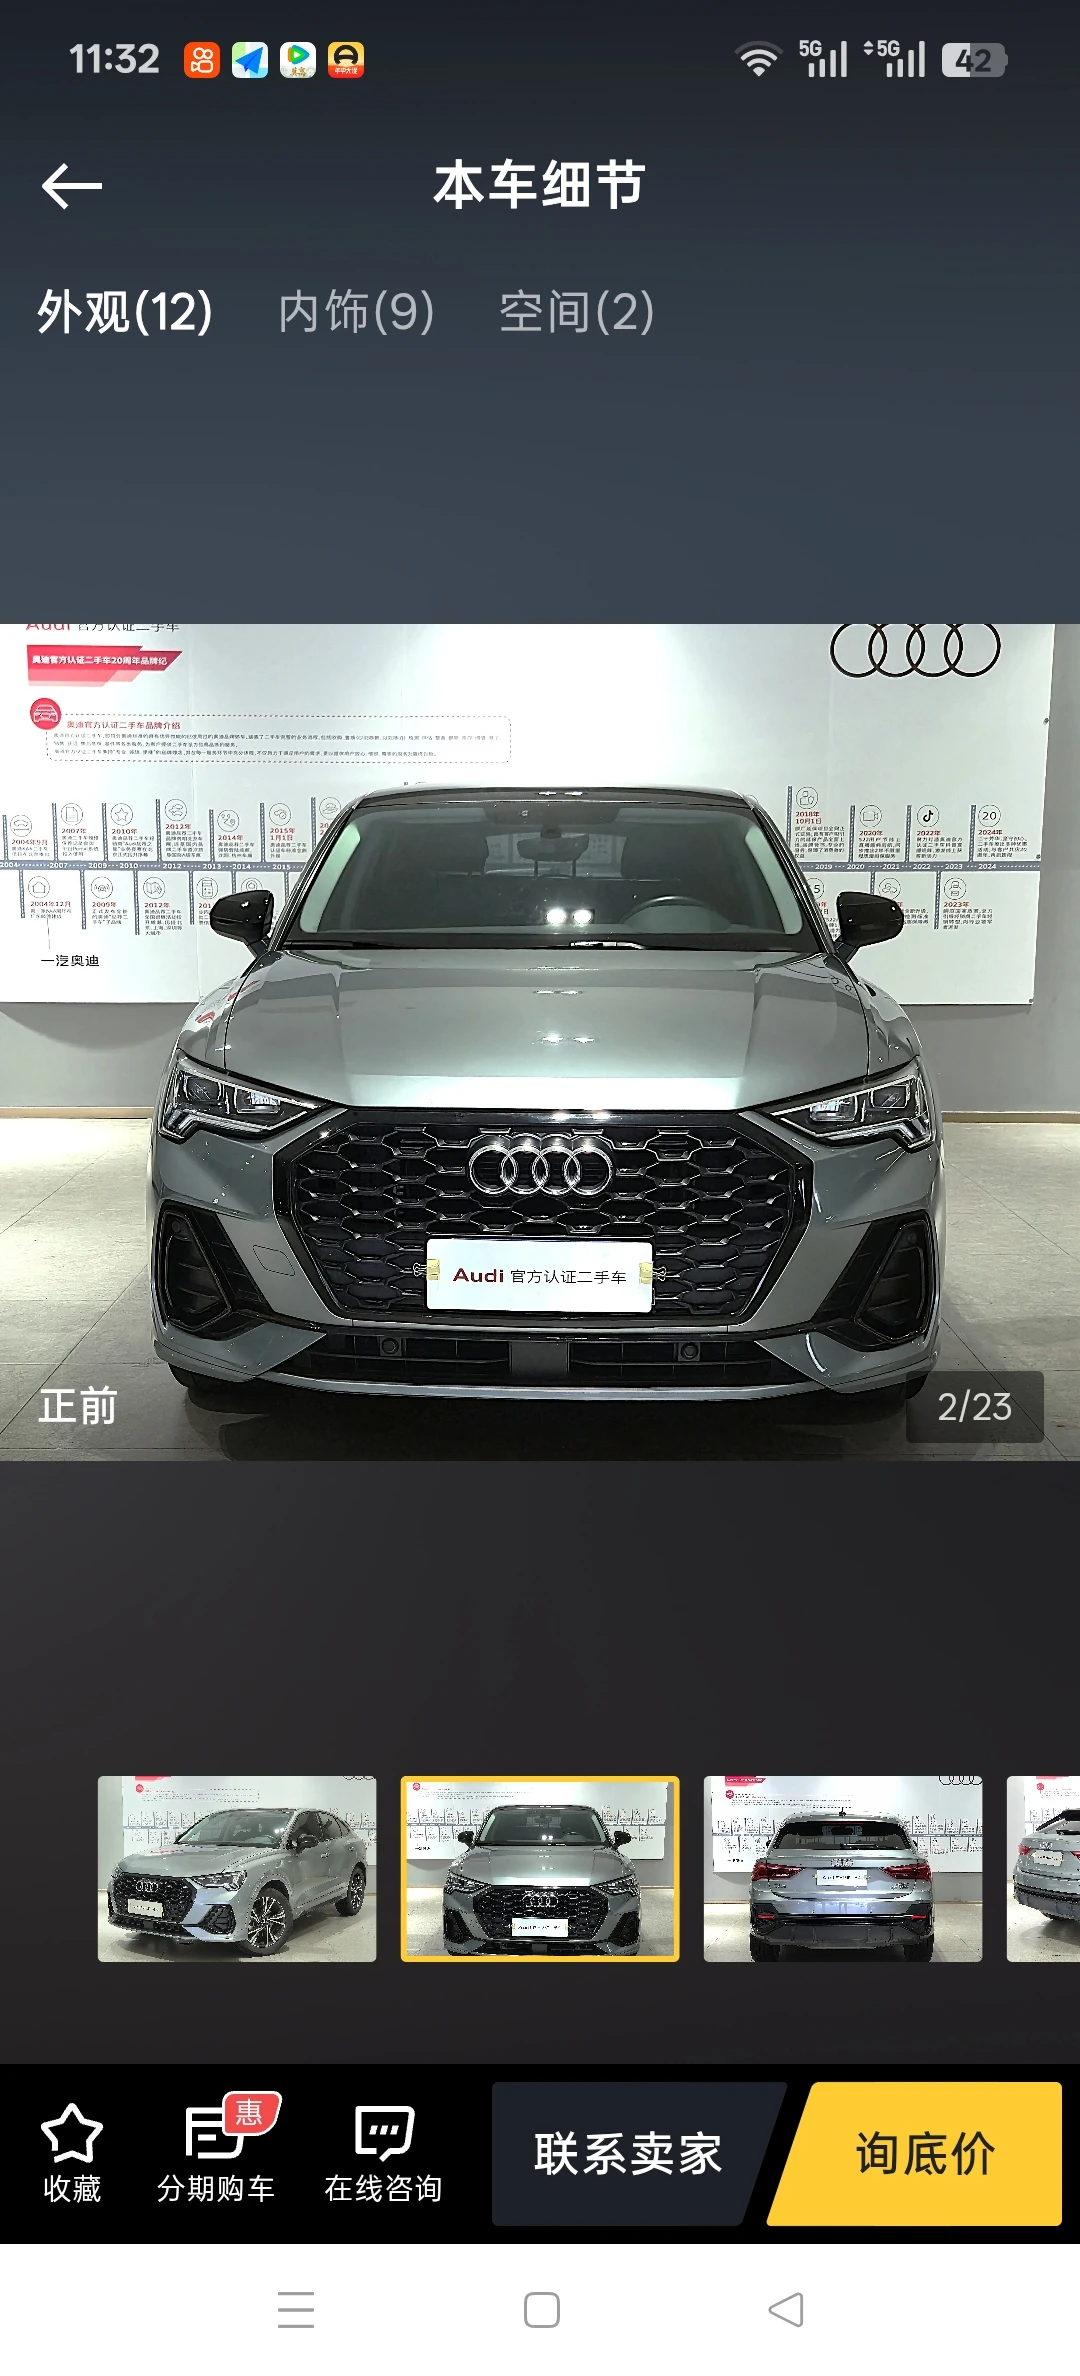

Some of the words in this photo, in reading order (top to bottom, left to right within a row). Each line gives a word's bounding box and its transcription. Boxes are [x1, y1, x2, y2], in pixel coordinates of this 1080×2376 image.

[70, 44, 159, 74] 11:32
[799, 40, 823, 57] 5G
[877, 40, 901, 57] 5G
[955, 48, 992, 73] 42
[433, 158, 646, 210] 本车细节
[37, 288, 212, 337] 外观(12)
[279, 288, 433, 336] 内饰(9)
[499, 288, 654, 336] 空间(2)
[982, 811, 997, 821] 20
[41, 955, 100, 967] 一汽奥迪
[453, 1268, 504, 1283] Audi
[510, 1269, 627, 1285] 官方认证二手车
[235, 2098, 263, 2126] 惠
[533, 2130, 723, 2176] 联系卖家
[855, 2130, 996, 2176] 询底价
[43, 2173, 102, 2204] 收藏
[156, 2173, 275, 2203] 分期购车
[324, 2173, 442, 2203] 在线咨询
